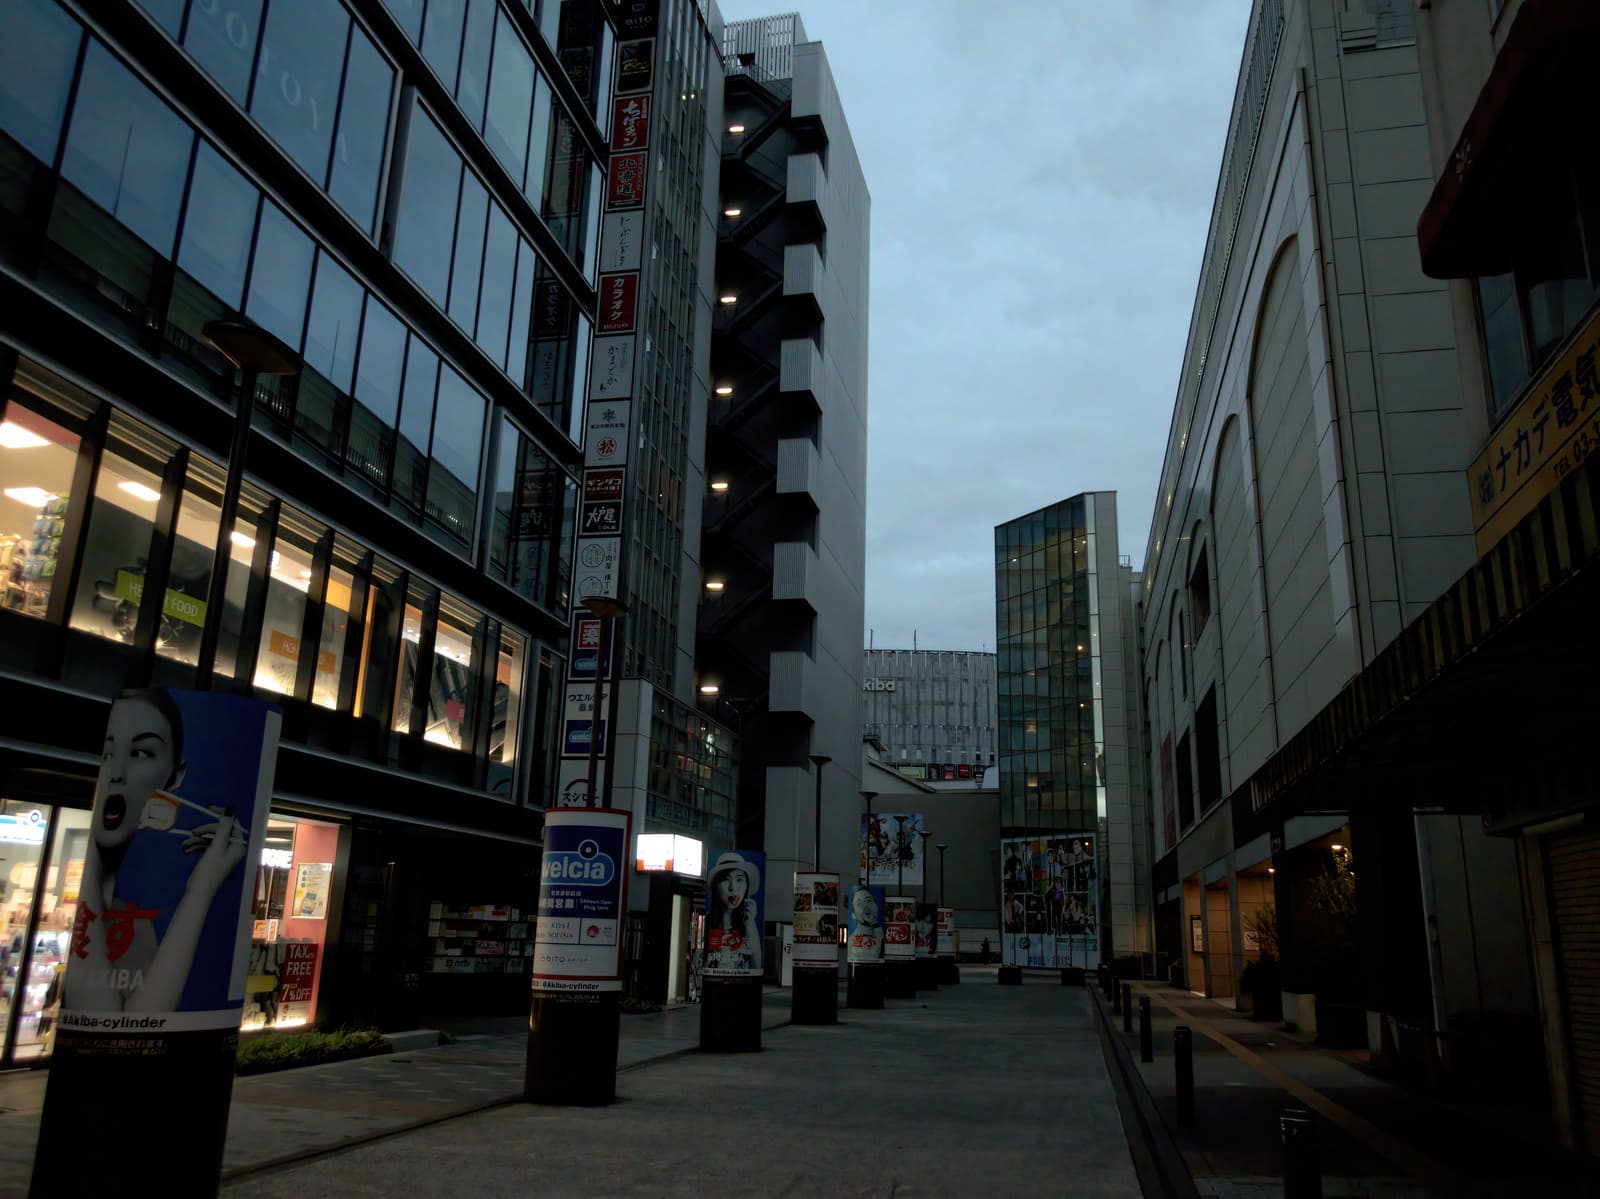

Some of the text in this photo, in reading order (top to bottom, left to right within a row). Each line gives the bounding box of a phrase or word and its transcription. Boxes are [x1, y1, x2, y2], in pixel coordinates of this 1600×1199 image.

[610, 277, 625, 320] カラオケ
[585, 506, 616, 528] 大戸屋
[171, 597, 199, 617] FOOD
[568, 694, 608, 702] ウエルア
[289, 945, 308, 959] TAX
[286, 961, 312, 977] FREE
[63, 1014, 167, 1028] #Akiba-cylinder
